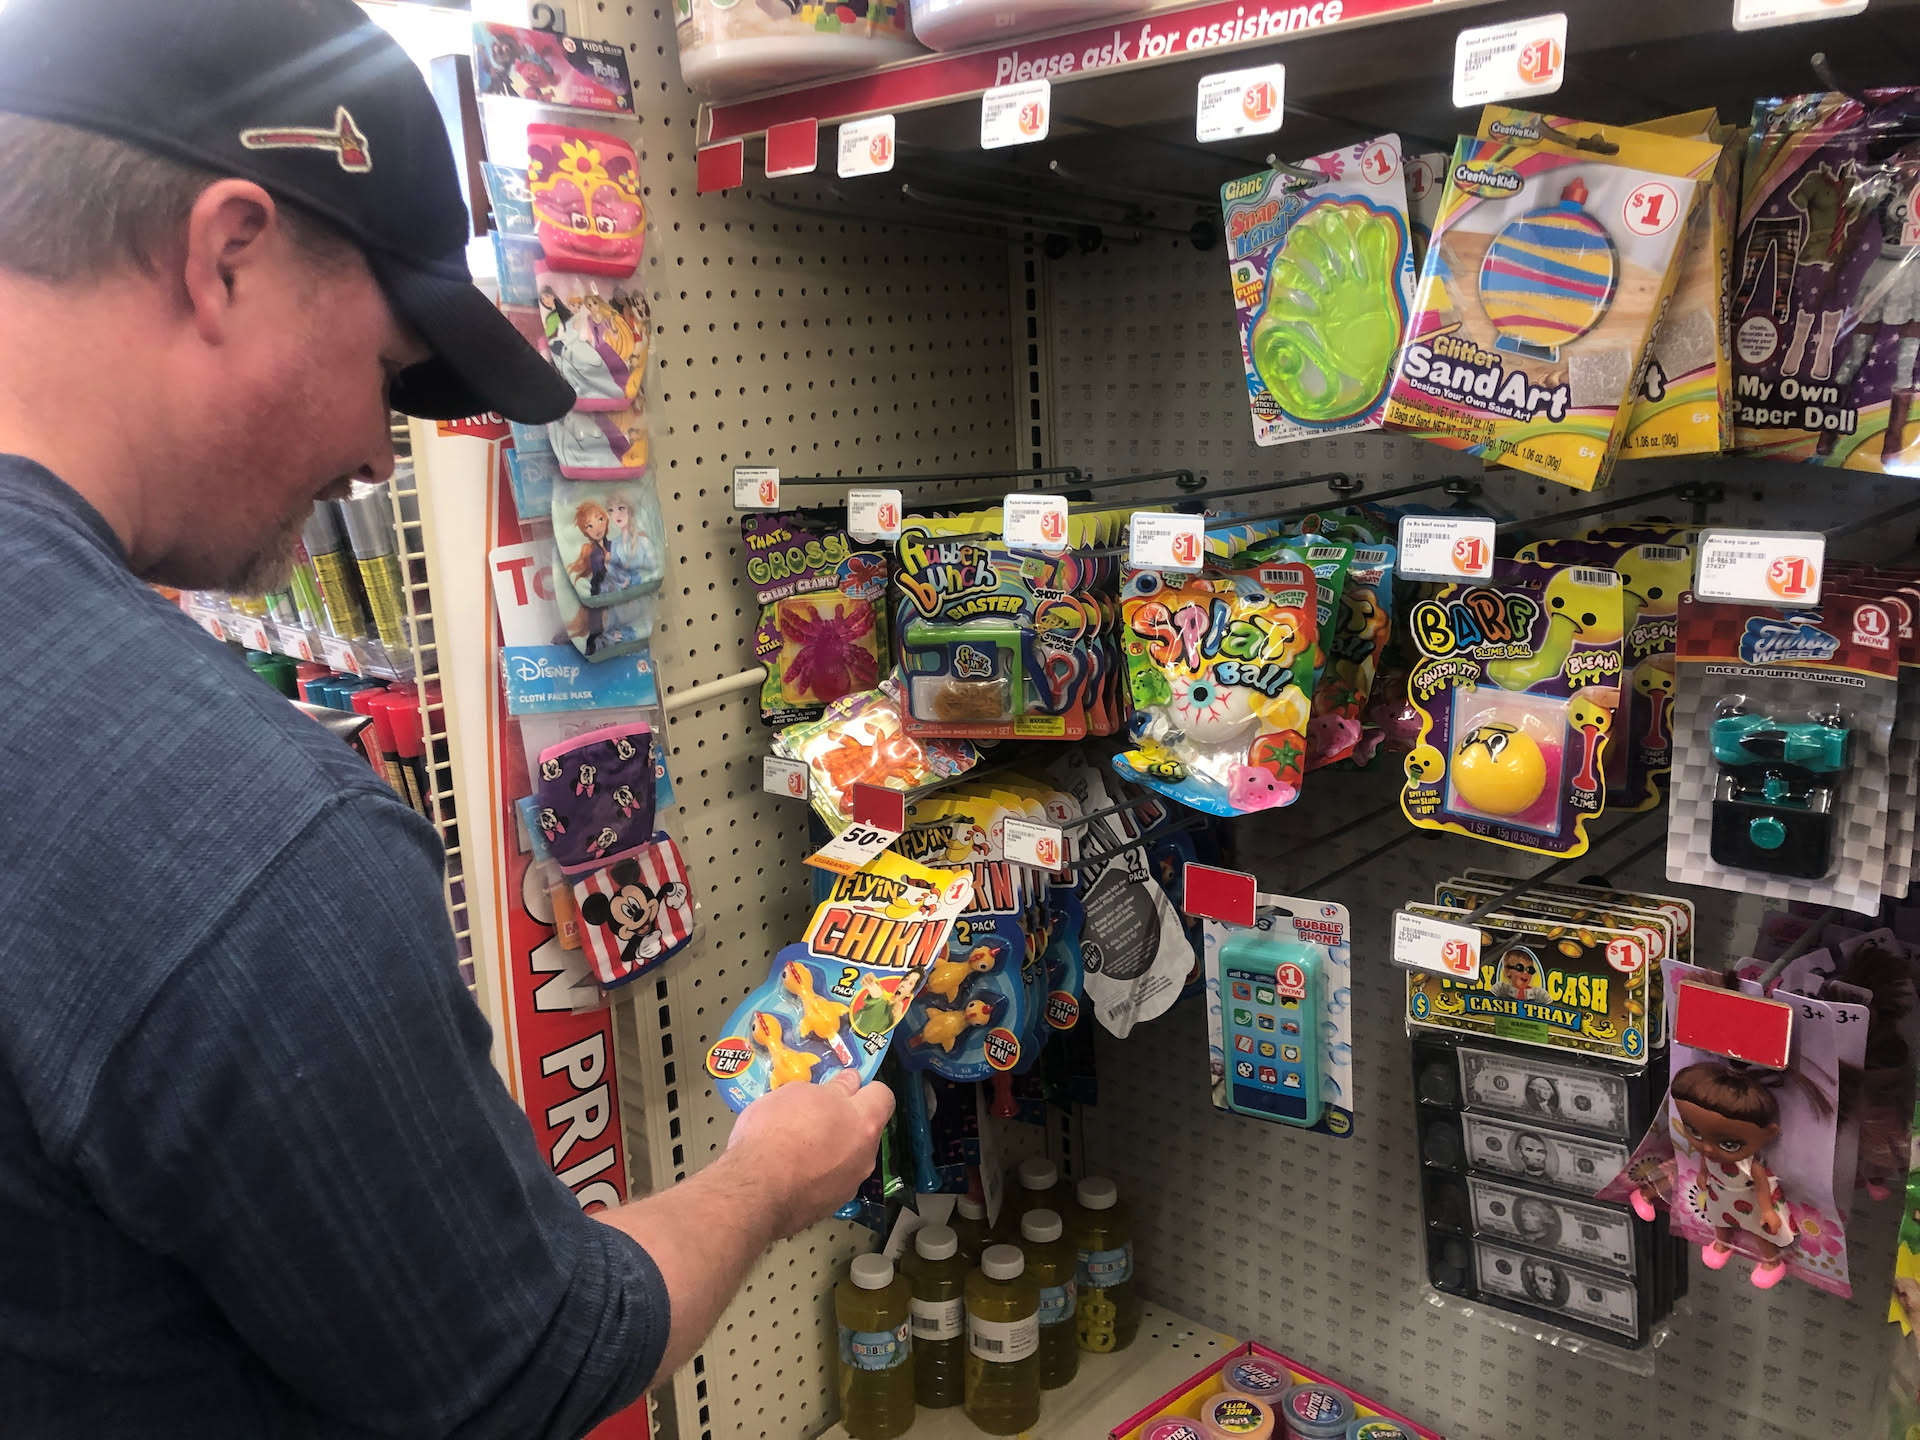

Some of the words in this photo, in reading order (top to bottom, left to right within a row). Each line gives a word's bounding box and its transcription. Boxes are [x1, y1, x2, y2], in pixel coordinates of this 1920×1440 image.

[995, 52, 1074, 86] Please
[1082, 31, 1131, 70] ask
[1138, 25, 1179, 60] for
[1186, 1, 1343, 48] assistance
[1523, 41, 1553, 78] $1
[1247, 84, 1271, 116] $1
[1022, 104, 1039, 130] $1
[872, 136, 888, 160] $1
[1364, 149, 1391, 176] $1
[1225, 177, 1262, 200] Giant
[1231, 200, 1279, 240] Snap
[1632, 194, 1664, 227] $1
[1236, 280, 1263, 300] FLING
[1433, 336, 1500, 369] Glitter
[1405, 346, 1500, 398] Sand
[1499, 374, 1568, 418] Art
[1738, 375, 1773, 400] My
[1780, 379, 1838, 403] Own
[1410, 378, 1441, 396] Design
[1443, 388, 1464, 401] Your
[1466, 395, 1486, 409] Own
[1488, 402, 1512, 417] Sand
[1514, 411, 1532, 422] Art
[1805, 406, 1855, 432] Doll
[1395, 411, 1408, 424] Bags
[1409, 414, 1416, 424] of
[1433, 420, 1445, 433] NET
[1457, 429, 1471, 442] 0.35
[1500, 440, 1519, 456] TOTAL
[1522, 448, 1534, 460] 1.06
[1545, 455, 1561, 471] (30g)
[1662, 433, 1679, 448] (30g)
[1579, 447, 1596, 459] 6+
[761, 481, 774, 502] $1
[880, 504, 895, 527] $1
[1044, 513, 1061, 537] $1
[746, 528, 792, 550] THAT'S
[1175, 535, 1196, 561] $1
[748, 533, 851, 584] GROSS!
[1456, 539, 1483, 570] $1
[1772, 559, 1807, 593] $1
[757, 583, 795, 604] CREEPY
[797, 574, 840, 592] CRAWLY
[1035, 589, 1064, 601] SHOOT
[947, 596, 1023, 620] BLASTER
[1415, 588, 1535, 655] BARF
[1860, 612, 1880, 633] $1
[759, 632, 770, 644] 6
[1858, 635, 1884, 646] WOW
[1475, 646, 1504, 657] SLIME
[1507, 645, 1531, 656] BALL
[1753, 650, 1832, 663] WHEELS
[1568, 654, 1619, 674] BLEAH!
[1417, 663, 1457, 688] SQUISH
[1459, 662, 1479, 678] IT!
[1706, 665, 1738, 675] RACE
[1740, 668, 1764, 676] CAR
[1767, 671, 1799, 679] WITH
[1802, 672, 1865, 687] LAUNCHER
[519, 693, 545, 703] CLOTH
[547, 692, 568, 701] FACE
[570, 691, 593, 700] MASK
[999, 727, 1010, 735] SET
[790, 774, 802, 793] $1
[1049, 805, 1067, 820] $1
[1569, 796, 1597, 809] SLIME!
[1476, 823, 1490, 834] SET
[1497, 828, 1509, 840] 15g
[1039, 840, 1055, 863] $1
[1125, 849, 1139, 869] 2
[1129, 869, 1148, 883] PACK
[838, 873, 907, 903] FLYIN'
[951, 884, 964, 900] $1
[1326, 907, 1336, 916] 3+
[956, 921, 971, 945] 2
[972, 919, 996, 933] PACK
[1295, 919, 1341, 933] BUBBLE
[813, 908, 947, 968] CHIK'N
[1300, 931, 1340, 945] PHONE
[1446, 942, 1470, 971] $1
[1610, 945, 1635, 967] $1
[841, 967, 860, 988] 2
[831, 985, 855, 997] PACK
[1548, 971, 1608, 1014] CASH
[1469, 996, 1518, 1015] CASH
[1524, 1003, 1577, 1026] TRAY
[1803, 1005, 1825, 1021] 3+
[1836, 1009, 1860, 1024] 3+
[986, 1034, 1017, 1052] STRETCH
[713, 1048, 752, 1060] STRETCH
[990, 1047, 1007, 1062] EM!
[717, 1058, 740, 1072] EM!
[853, 1342, 896, 1356] BUBBLES
[1241, 1363, 1277, 1382] GLITTER
[1246, 1374, 1272, 1389] PUTTY
[1225, 1408, 1253, 1416] NOICE
[1305, 1391, 1323, 1420] GLITTER
[1320, 1395, 1333, 1412] PUTTY
